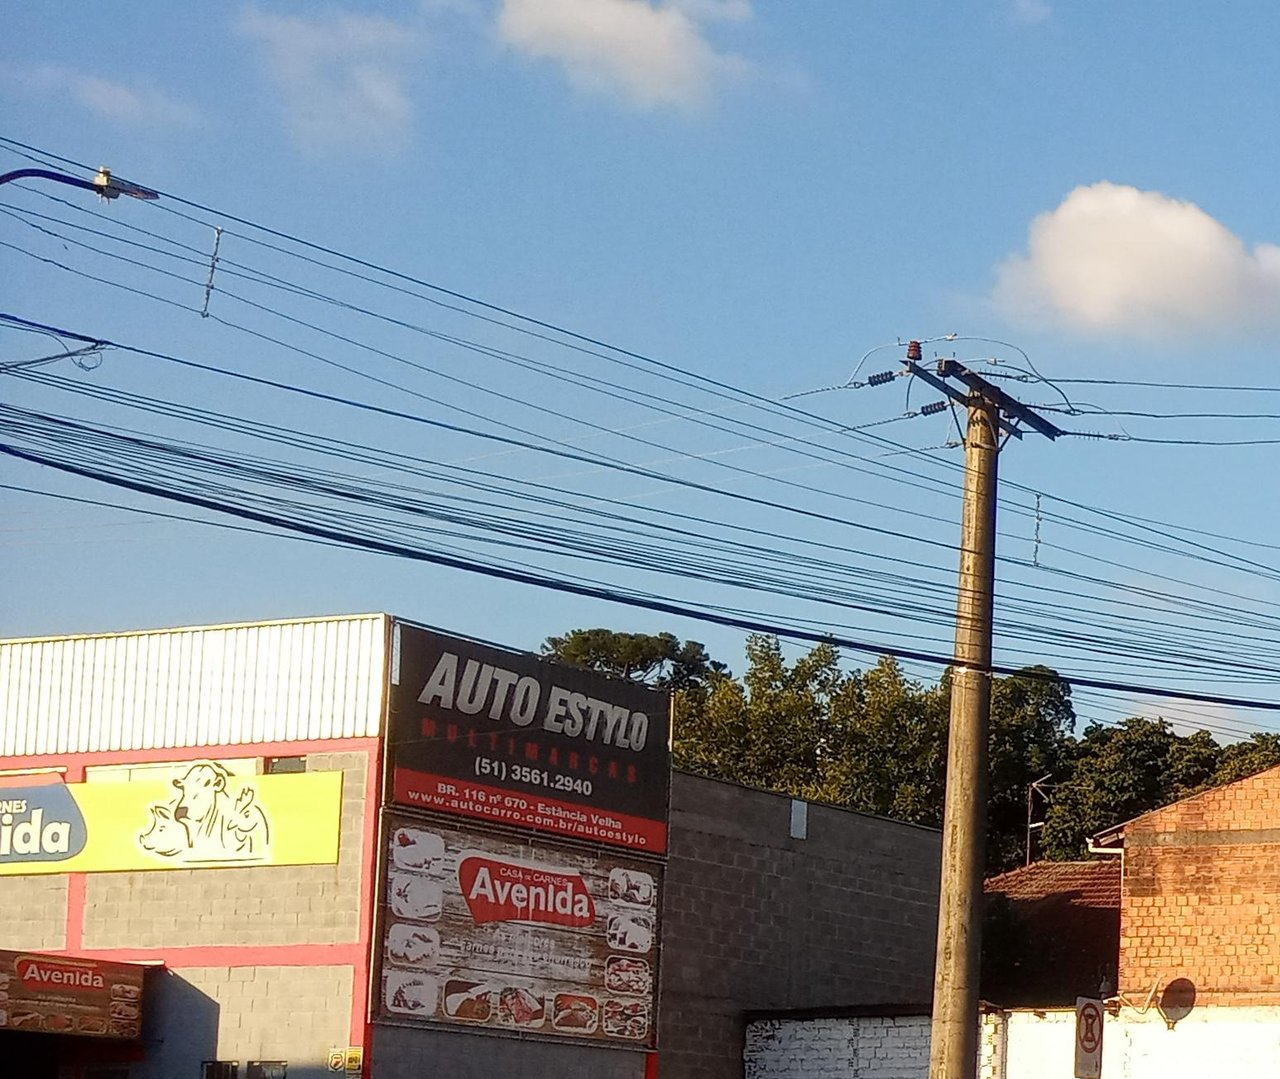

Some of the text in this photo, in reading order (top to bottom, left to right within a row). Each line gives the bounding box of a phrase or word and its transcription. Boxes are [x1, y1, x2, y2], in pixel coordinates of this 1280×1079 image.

[417, 651, 649, 752] AUTO ESTYLO
[420, 717, 637, 783] MULTIMARCAS
[475, 756, 593, 796] (51) 3561.2940
[437, 782, 459, 796] BR.
[463, 787, 486, 801] 116
[504, 795, 528, 810] 670
[537, 802, 587, 823] Estância
[591, 813, 622, 830] Velha
[469, 867, 590, 918] Avenida
[500, 867, 525, 881] CASA
[533, 873, 569, 887] CARNES
[23, 963, 104, 988] Avenida
